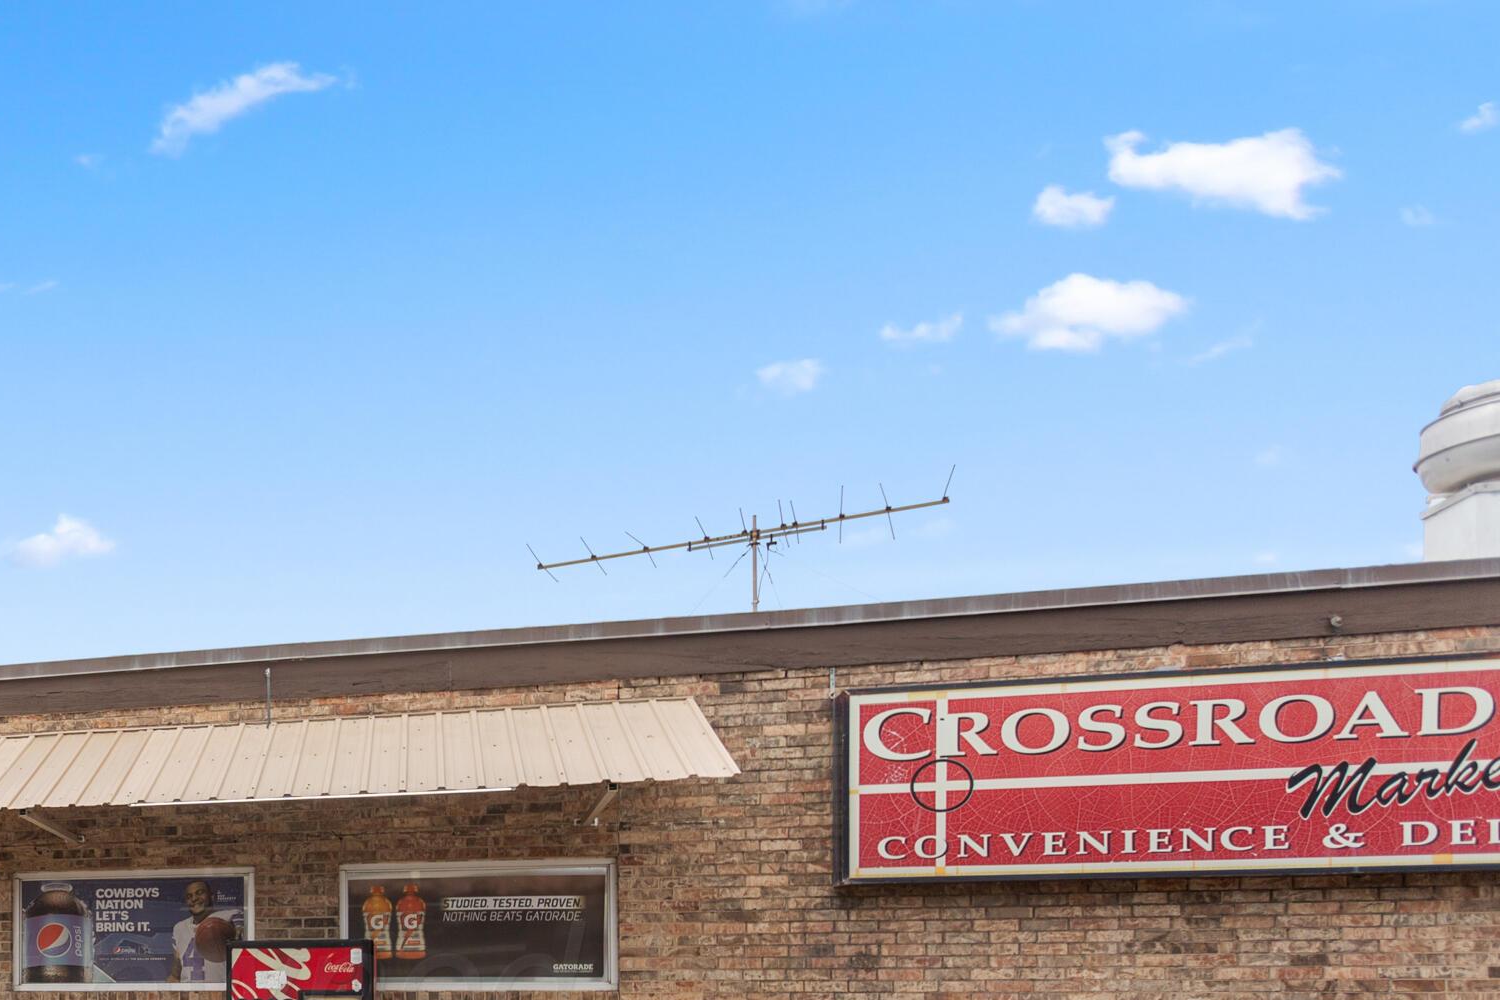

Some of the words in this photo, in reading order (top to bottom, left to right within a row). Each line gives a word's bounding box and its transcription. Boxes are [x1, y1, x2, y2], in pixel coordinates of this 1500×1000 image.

[877, 823, 1291, 860] CONVENIENCE
[1322, 823, 1365, 849] &
[95, 887, 160, 898] COWBOYS
[95, 899, 143, 909] NATION
[443, 898, 489, 908] STUDIED.
[492, 898, 534, 908] TESTED.
[537, 897, 582, 908] PROVEN.
[95, 911, 129, 921] LET'S
[403, 913, 418, 930] G
[442, 911, 487, 922] NOTHING
[490, 911, 523, 922] BEATS
[525, 911, 583, 922] GATORADE.
[95, 922, 135, 933] BRING
[137, 921, 151, 932] IT.
[370, 914, 384, 930] G
[553, 963, 594, 971] GATORADE
